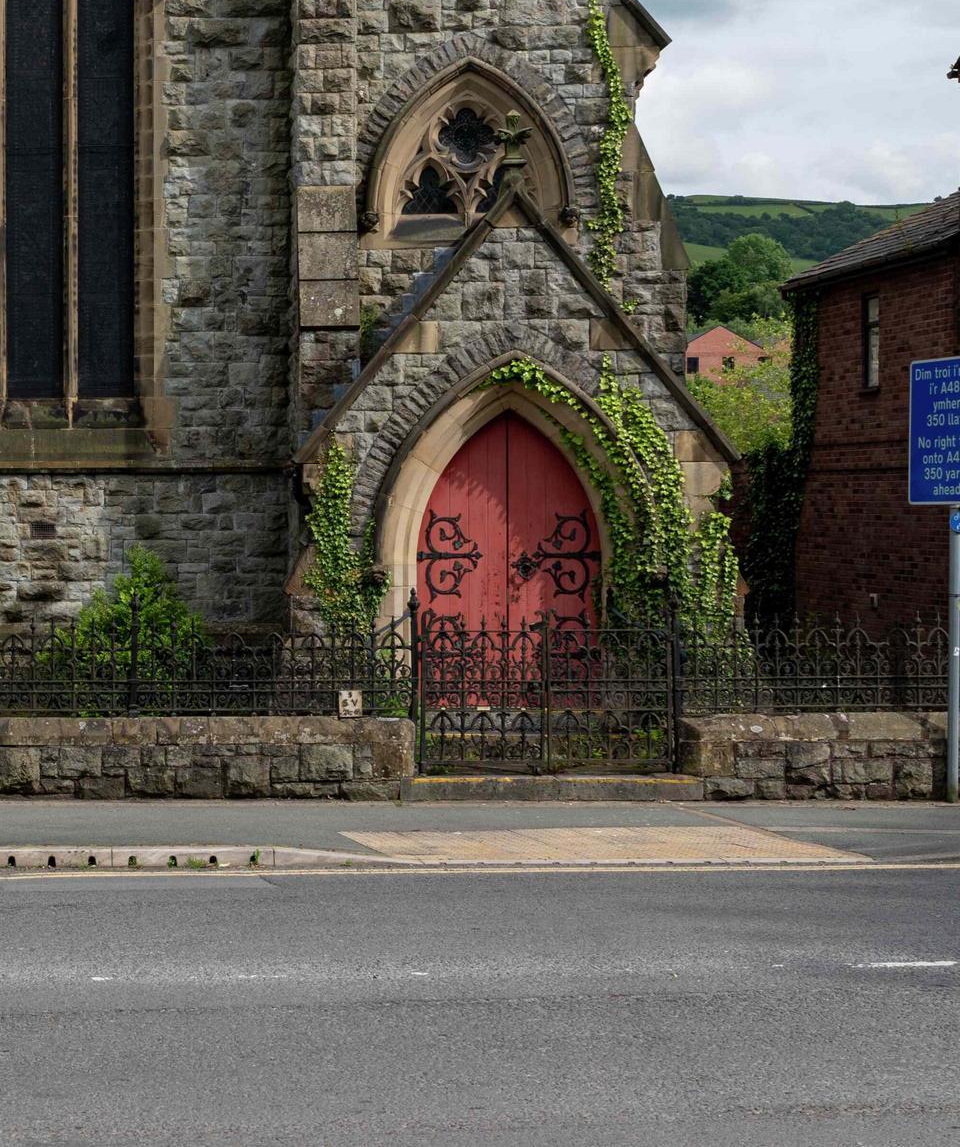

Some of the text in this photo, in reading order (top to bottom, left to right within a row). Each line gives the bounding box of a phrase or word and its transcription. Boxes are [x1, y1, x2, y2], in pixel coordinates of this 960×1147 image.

[915, 368, 932, 381] Dim
[935, 366, 951, 379] troi
[926, 413, 945, 426] 350
[918, 436, 932, 449] No
[934, 434, 956, 450] right
[922, 452, 944, 464] onto
[924, 467, 943, 480] 350
